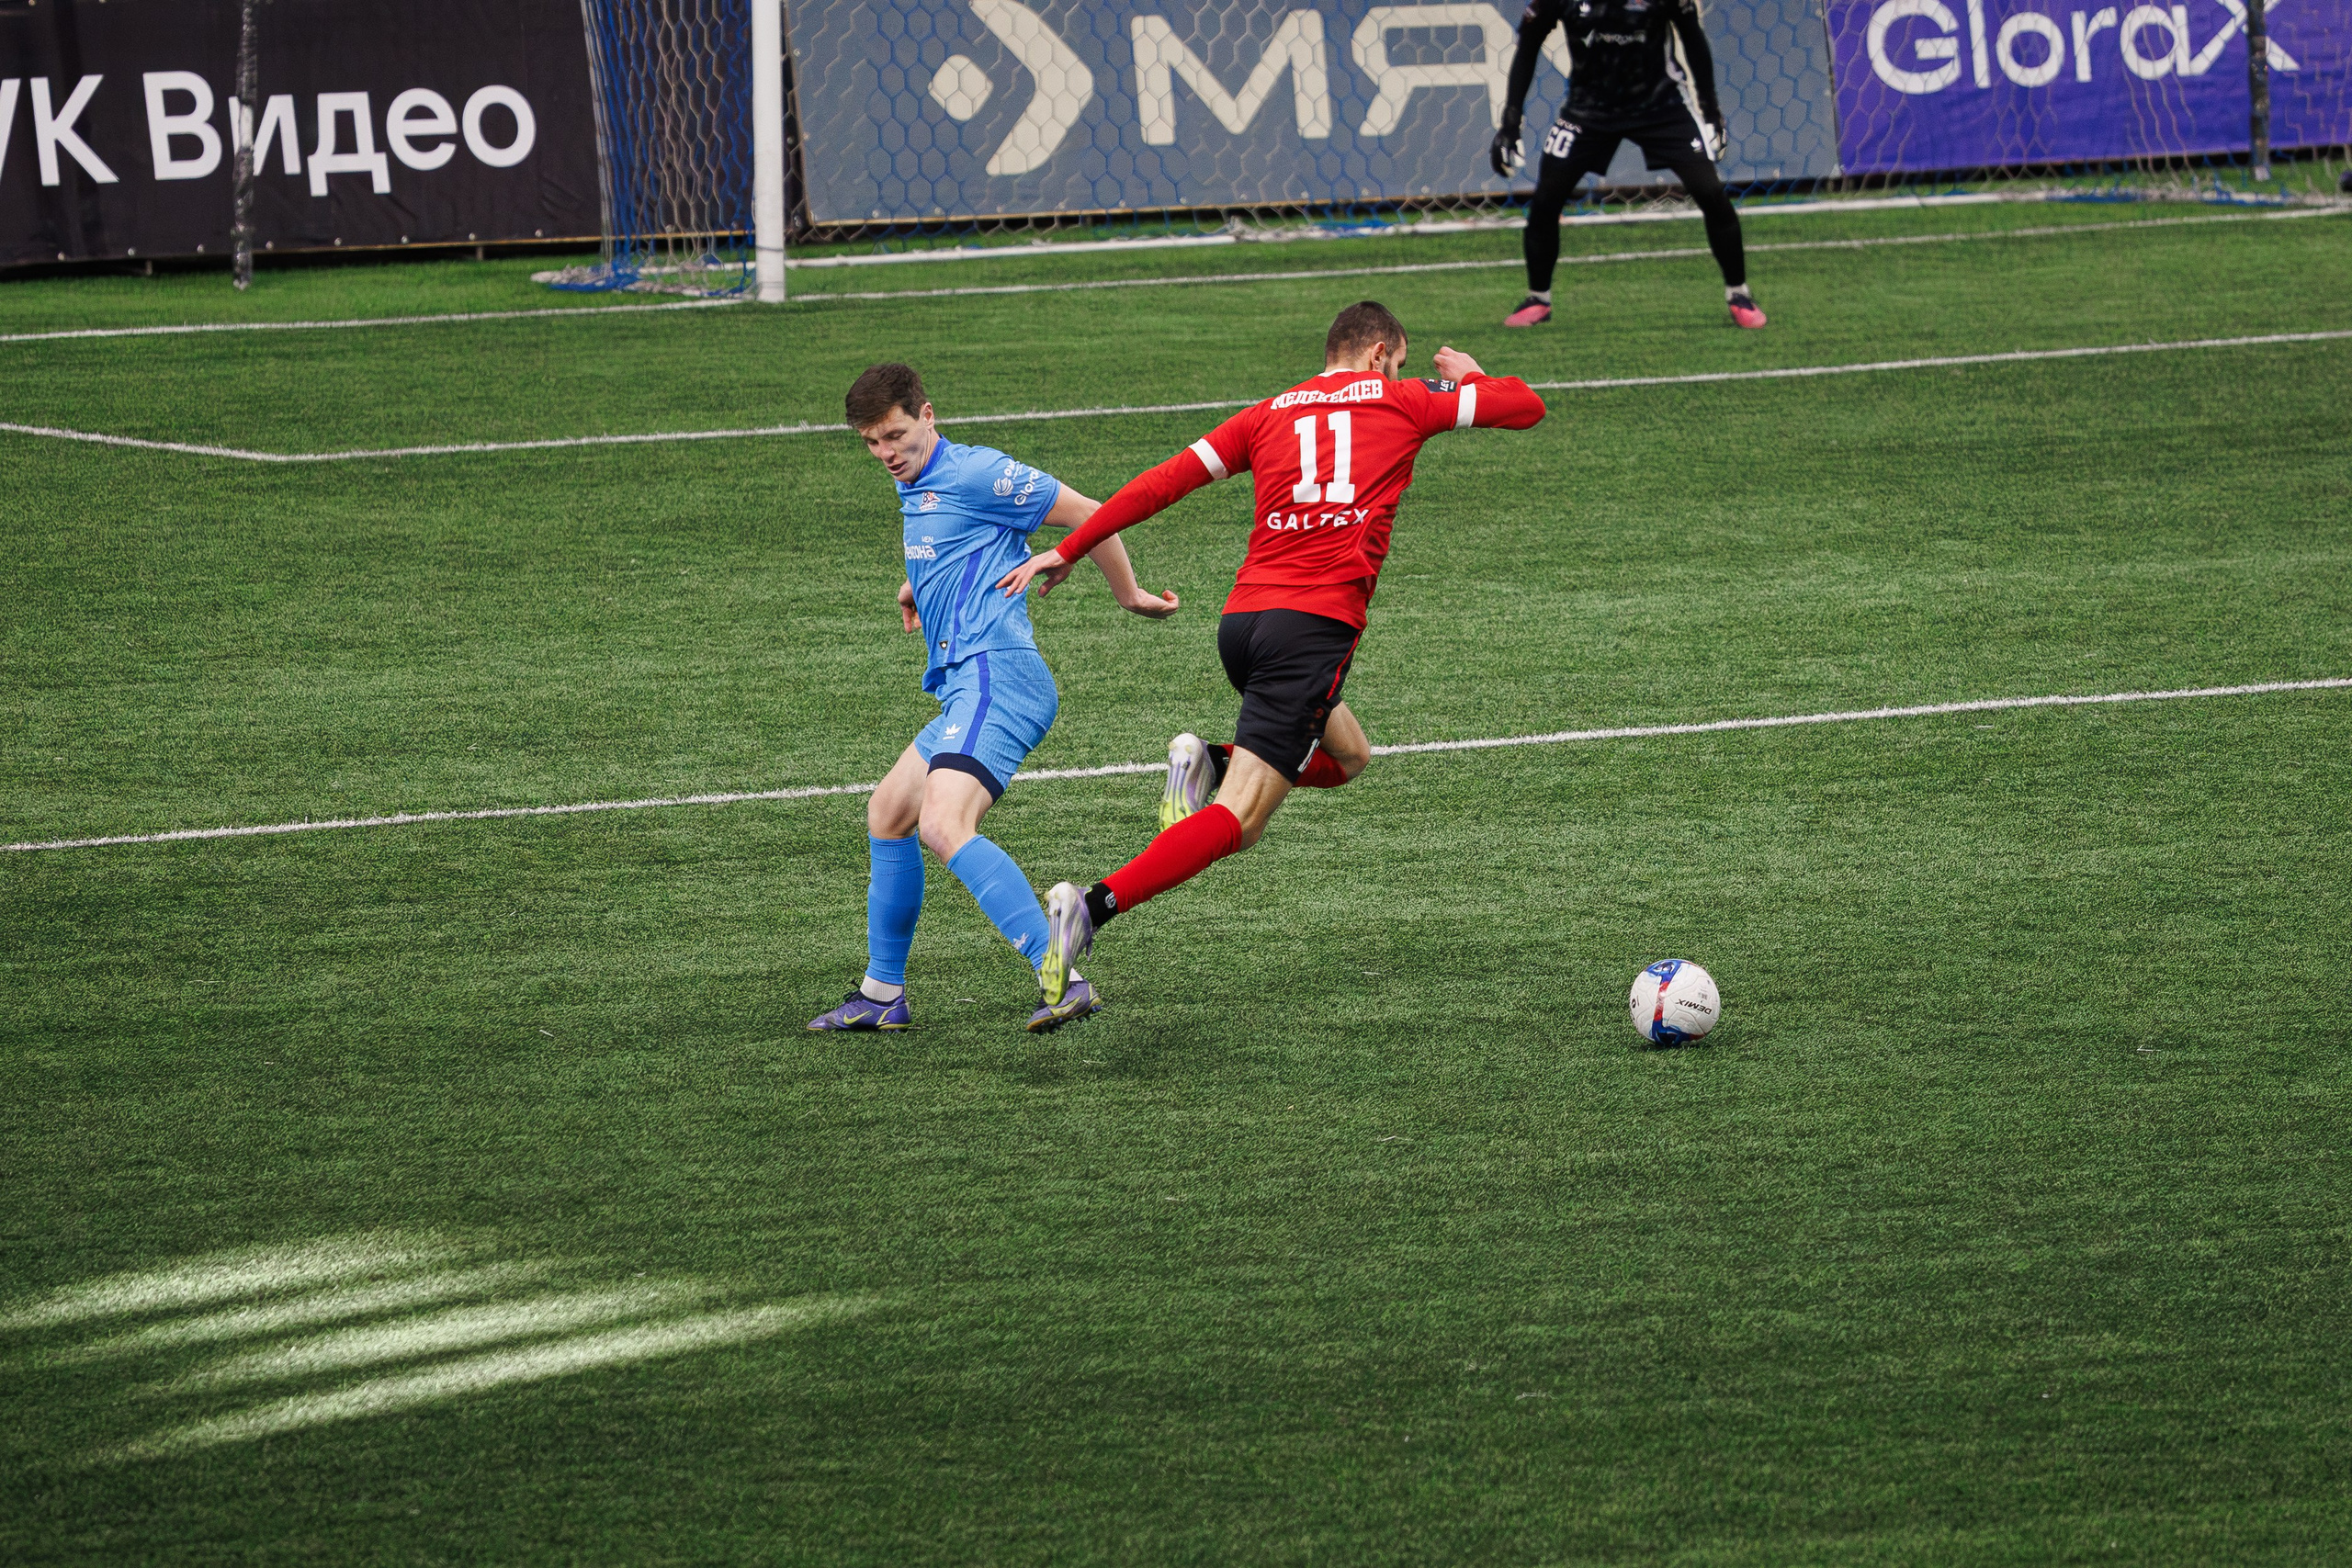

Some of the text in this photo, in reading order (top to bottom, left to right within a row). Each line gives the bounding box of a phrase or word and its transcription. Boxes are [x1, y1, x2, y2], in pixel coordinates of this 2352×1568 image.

[1867, 0, 2300, 95] GloraX
[142, 71, 537, 197] Видео
[1270, 378, 1383, 410] МЕЛЕКЕСЦЕВ
[1293, 411, 1355, 503] 11
[1014, 466, 1039, 505] Glora
[1267, 508, 1369, 530] GALTEX
[1675, 998, 1713, 1015] DEMIX
